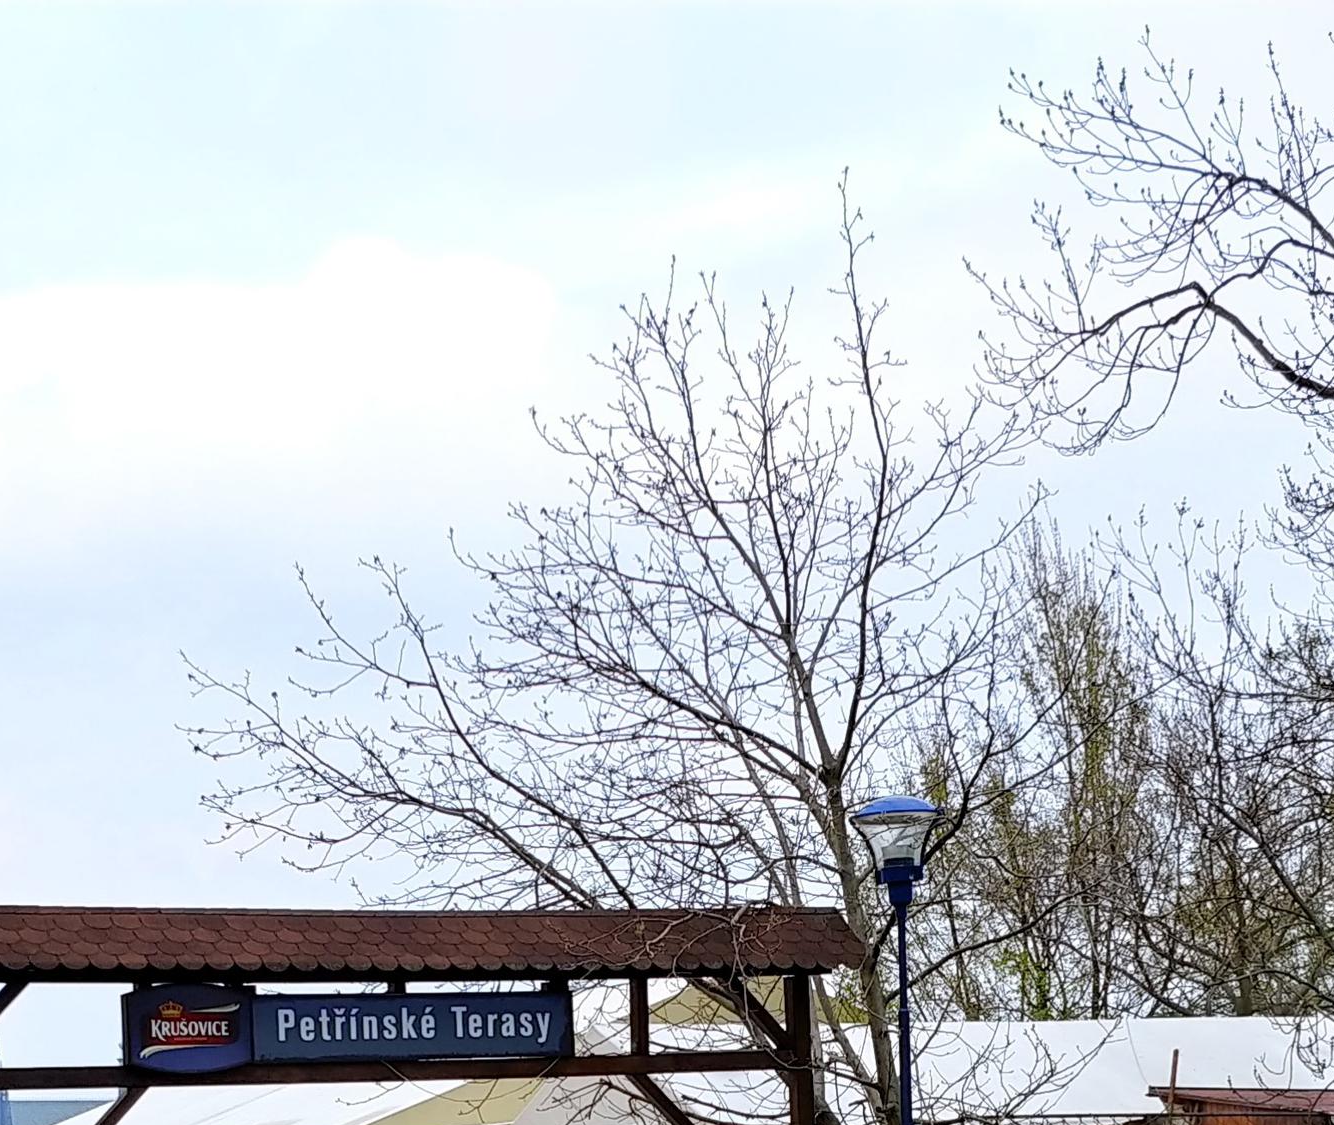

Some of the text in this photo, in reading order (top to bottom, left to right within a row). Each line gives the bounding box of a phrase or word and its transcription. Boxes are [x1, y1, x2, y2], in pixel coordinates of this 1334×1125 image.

[150, 1017, 230, 1042] KRUŠOVICE
[277, 1005, 551, 1044] Petřínské Terasy
